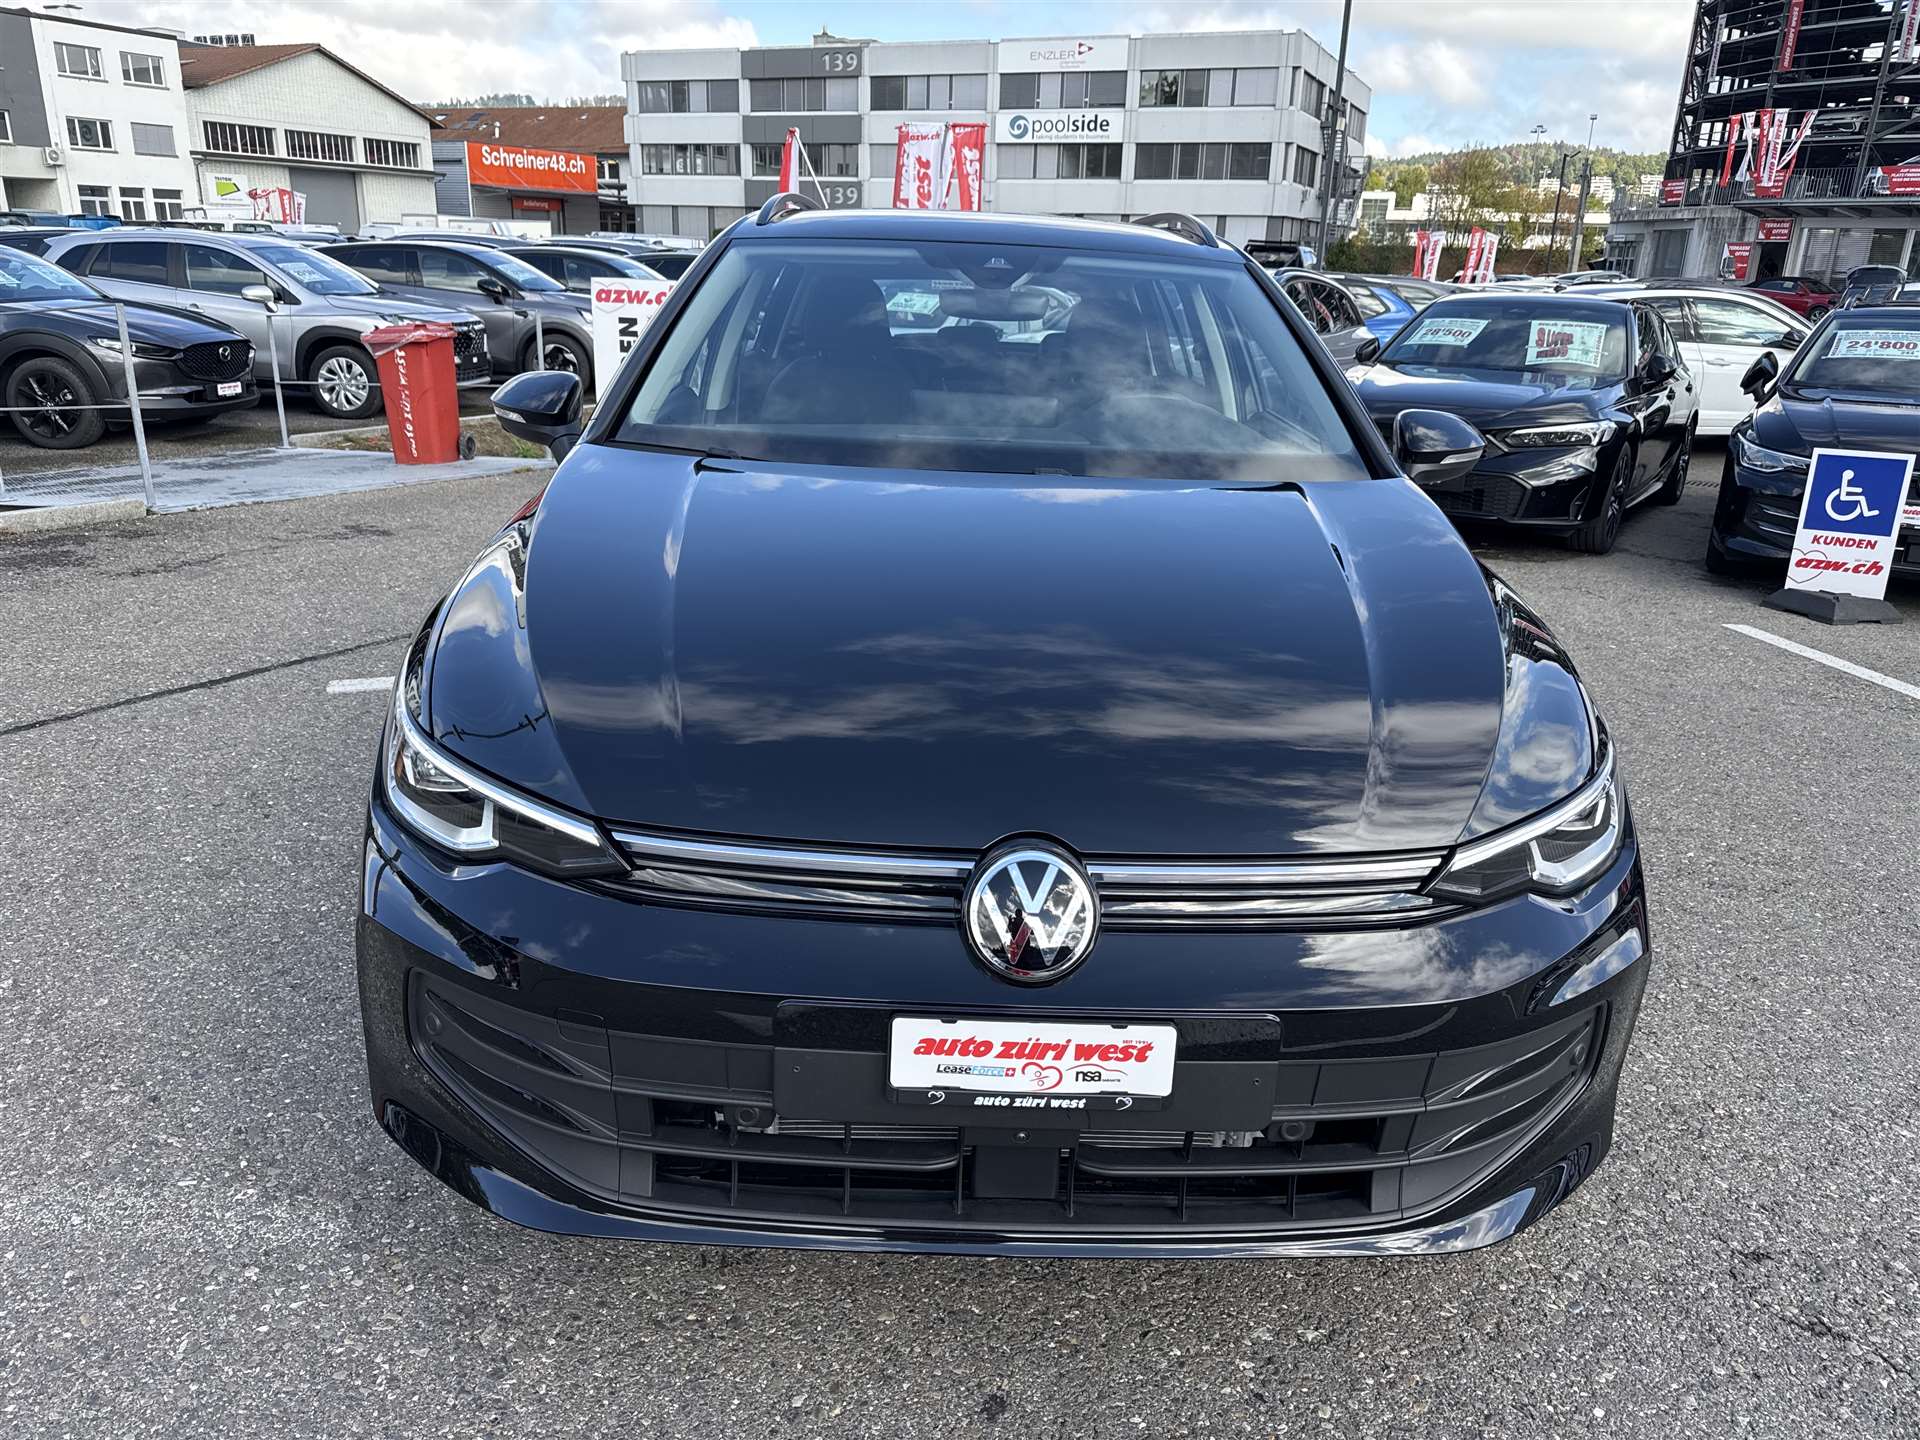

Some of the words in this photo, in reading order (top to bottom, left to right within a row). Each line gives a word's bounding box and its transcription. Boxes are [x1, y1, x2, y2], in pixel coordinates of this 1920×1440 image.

[822, 53, 858, 71] 139
[1030, 50, 1076, 61] ENZLER
[1032, 114, 1110, 139] poolside
[481, 145, 586, 174] Schreiner48.ch
[824, 187, 858, 205] 139
[618, 317, 638, 364] EN
[1423, 327, 1473, 338] 28'500
[1846, 341, 1918, 350] 24'800
[394, 348, 408, 385] west
[404, 423, 418, 458] auto
[1811, 534, 1878, 550] KUNDEN
[1794, 557, 1884, 576] azw.ch
[913, 1036, 993, 1058] auto
[995, 1037, 1072, 1062] züri
[1074, 1042, 1154, 1063] west
[936, 1063, 1005, 1077] LeaseForce
[1075, 1070, 1102, 1083] nsa
[974, 1096, 1010, 1107] auto
[1013, 1095, 1047, 1108] züri
[1050, 1097, 1086, 1109] west
